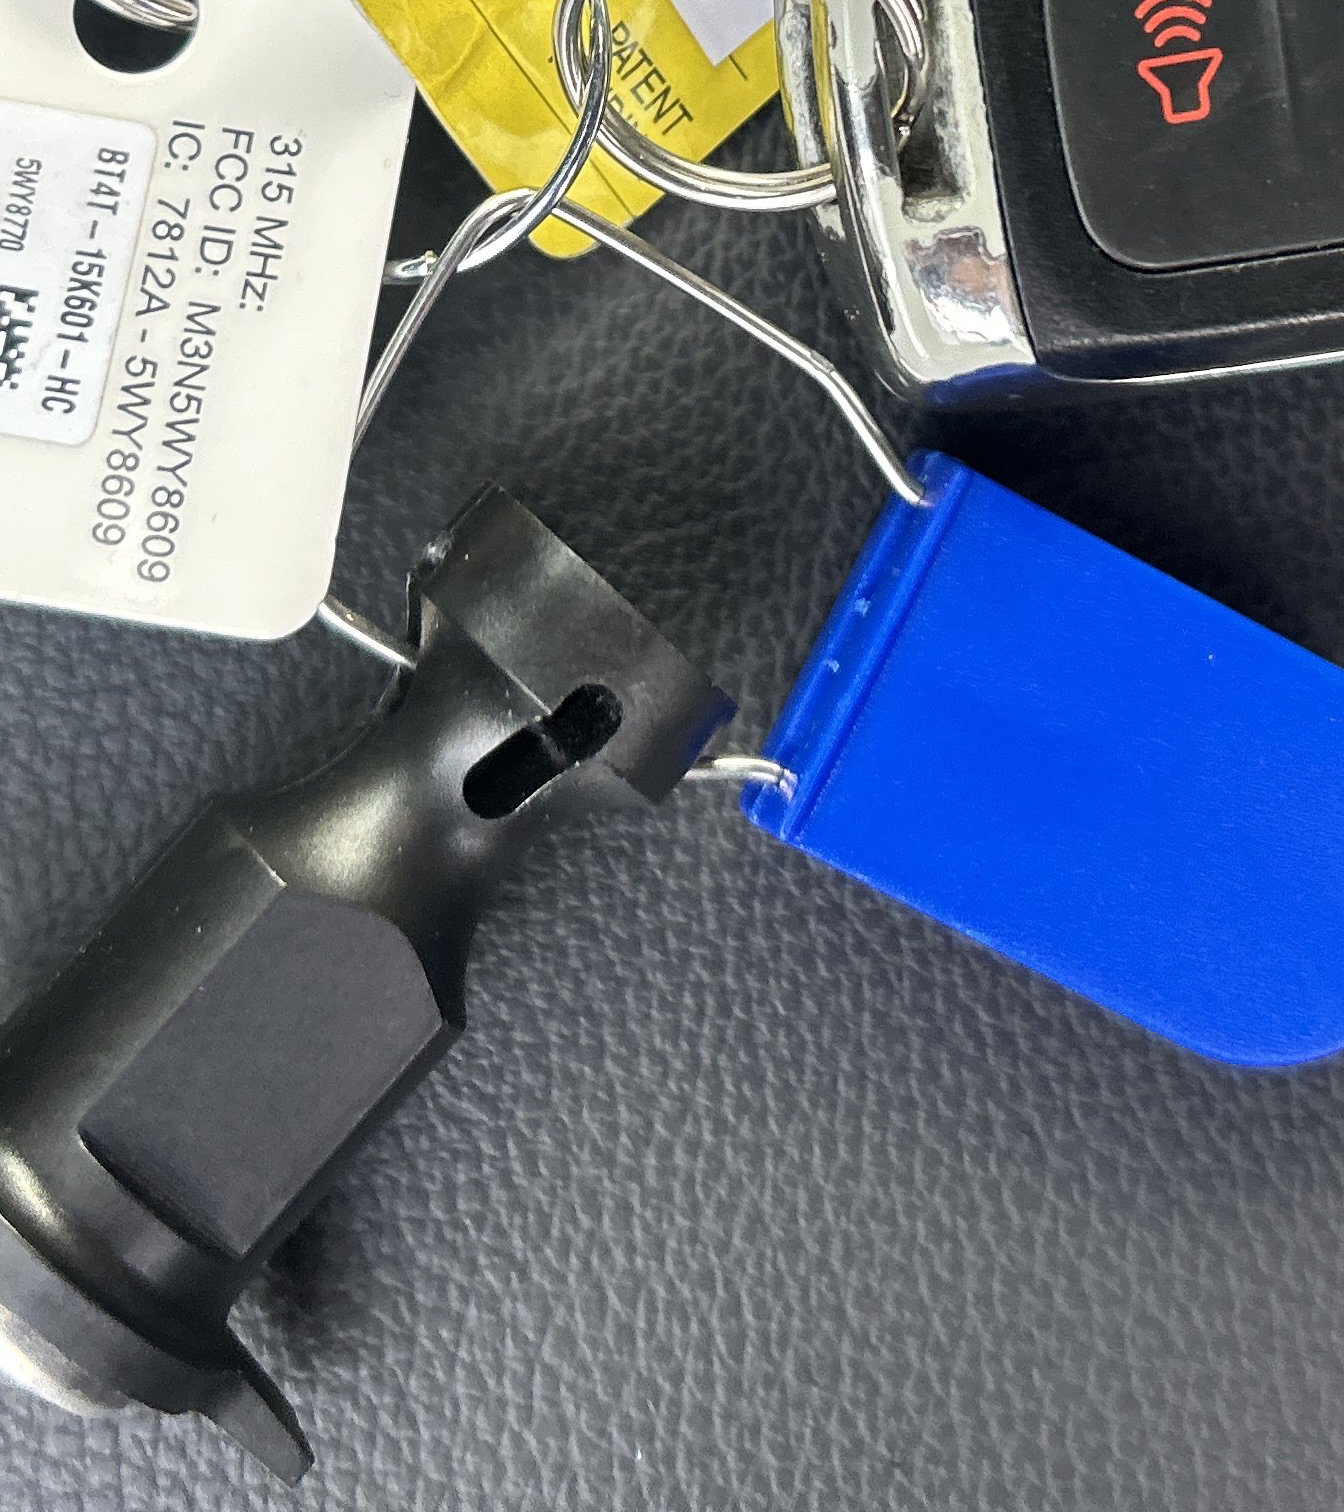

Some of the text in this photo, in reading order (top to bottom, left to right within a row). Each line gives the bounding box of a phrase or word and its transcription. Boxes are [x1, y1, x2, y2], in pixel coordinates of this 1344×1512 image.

[164, 120, 206, 172] IC:
[611, 20, 694, 136] PATENT
[239, 134, 304, 312] 315 MHz:
[136, 127, 256, 584] FCC ID: M3N5WY8609
